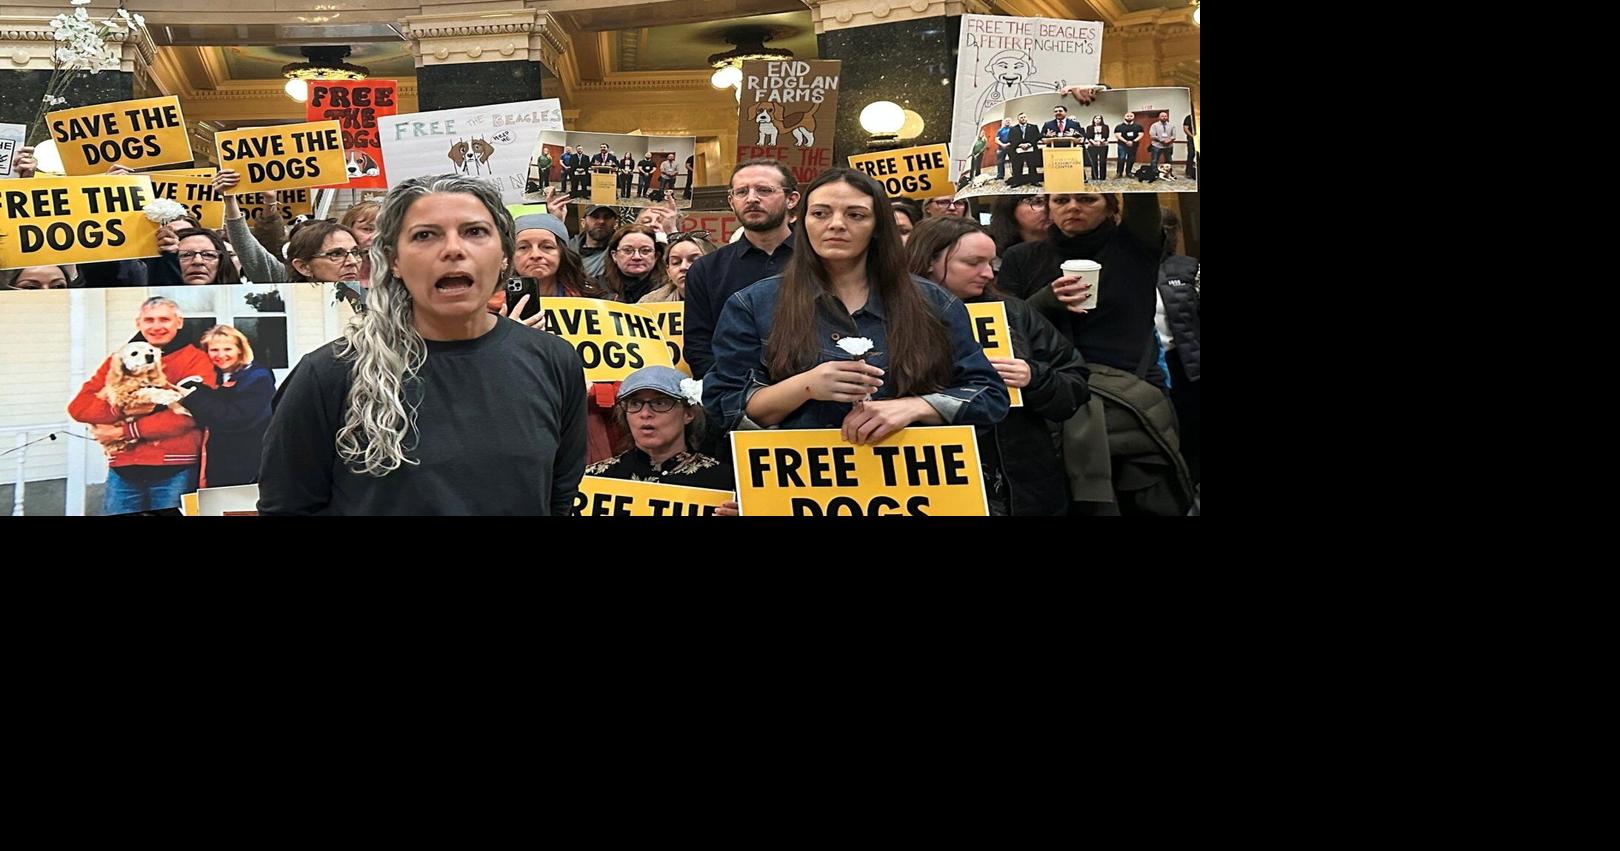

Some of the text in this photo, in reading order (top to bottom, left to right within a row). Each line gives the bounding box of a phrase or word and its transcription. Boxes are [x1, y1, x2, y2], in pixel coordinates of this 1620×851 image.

[967, 18, 1096, 40] FREE THE BEAGLES
[767, 61, 811, 77] END
[747, 75, 839, 90] RIDGLAN
[312, 86, 394, 107] FREE
[755, 88, 825, 104] FARMS
[53, 105, 180, 143] SAVE THE
[395, 108, 561, 141] FREE THE BEAGLES
[82, 134, 161, 165] DOGS
[221, 129, 339, 161] SAVE THE
[342, 130, 381, 149] OGS
[247, 156, 320, 183] DOGS
[799, 148, 832, 166] THE
[903, 151, 944, 172] THE
[82, 185, 146, 214] THE
[152, 181, 178, 199] VE
[18, 218, 126, 253] DOGS
[545, 309, 602, 335] AVE
[608, 311, 660, 340] THE
[575, 340, 644, 369] OGS
[748, 444, 969, 488] FREE THE
[571, 492, 633, 517] REE
